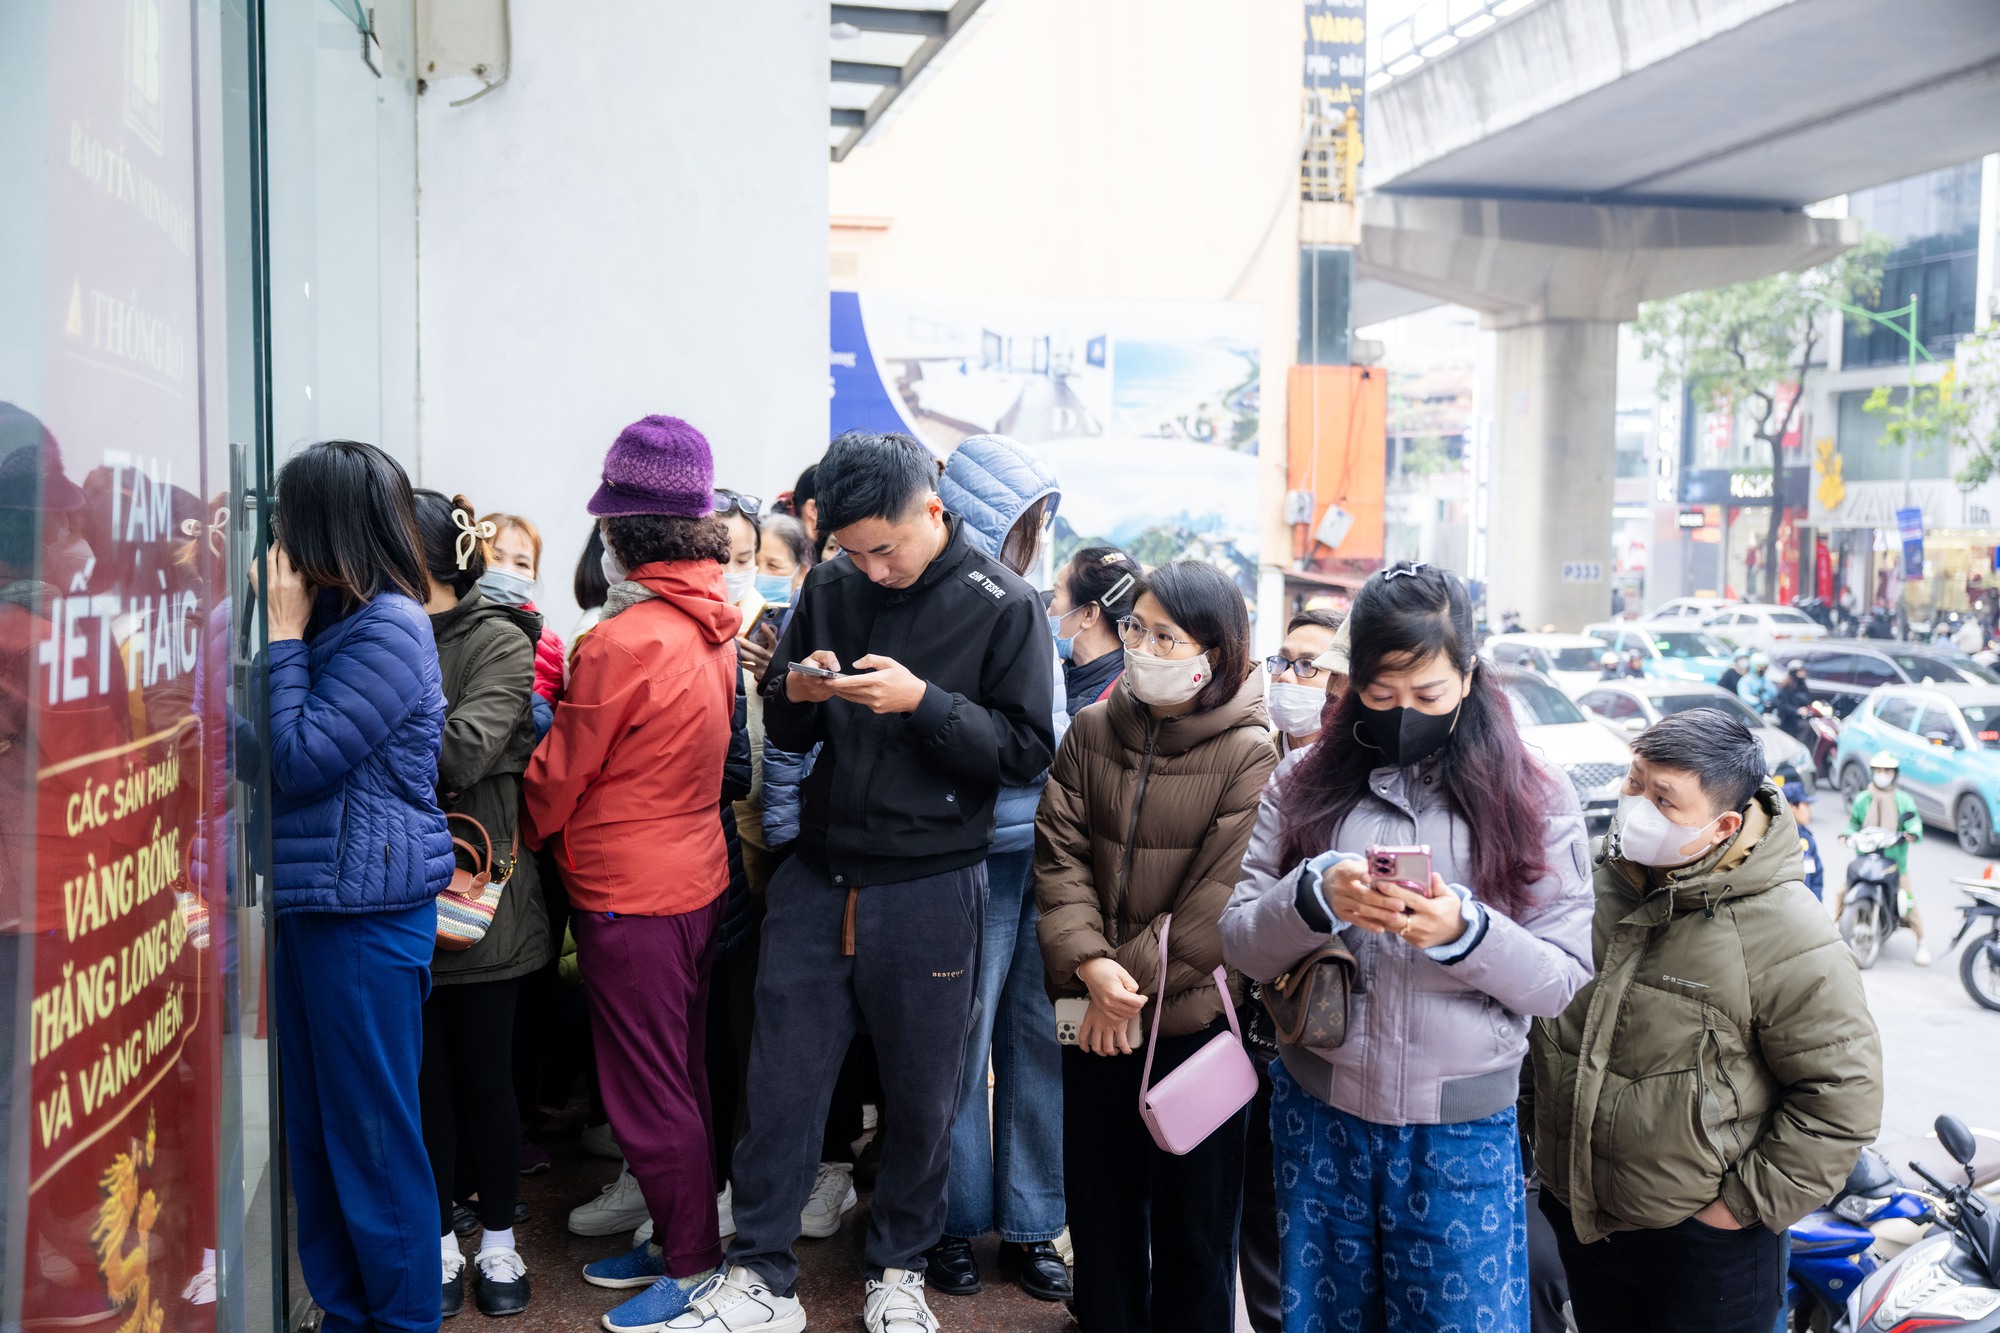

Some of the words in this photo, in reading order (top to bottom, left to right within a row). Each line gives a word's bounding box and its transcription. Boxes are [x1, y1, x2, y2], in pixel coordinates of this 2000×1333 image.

[90, 287, 164, 371] THÔNG
[66, 777, 109, 837] CÁC
[112, 761, 146, 821] SẢN
[63, 852, 134, 944] VÀNG
[136, 815, 180, 907] RỒNG
[121, 918, 166, 1007] LONG
[39, 1070, 73, 1149] VÀ
[79, 1028, 142, 1117] VÀNG
